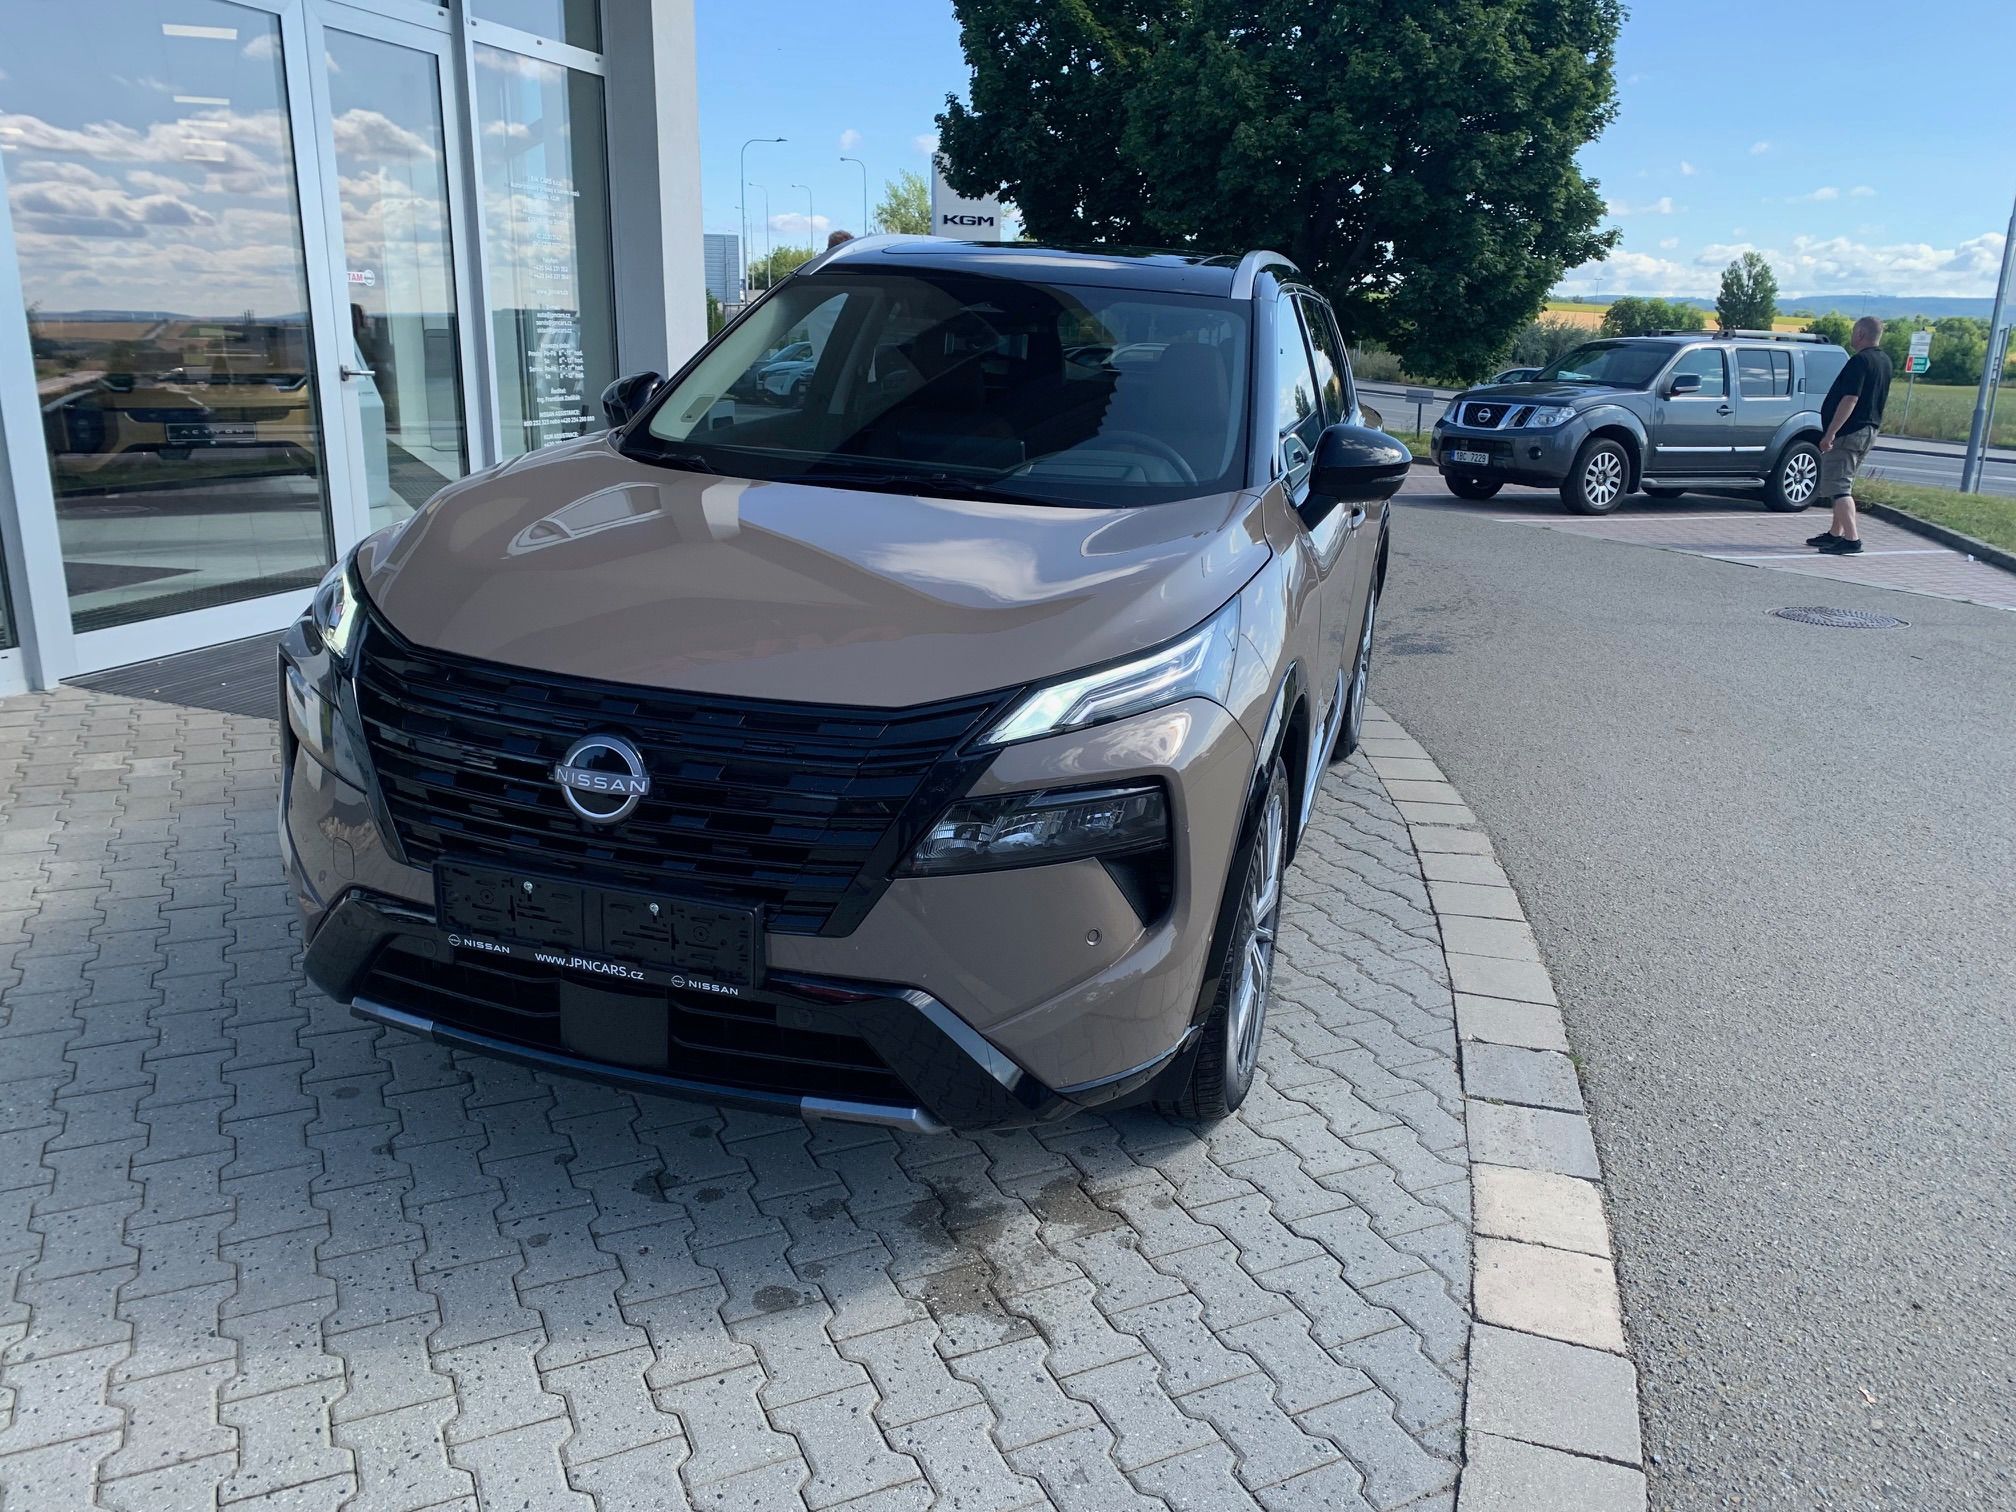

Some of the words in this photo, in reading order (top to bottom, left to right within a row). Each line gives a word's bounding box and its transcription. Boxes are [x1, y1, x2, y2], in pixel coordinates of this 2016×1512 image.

[943, 214, 994, 227] KGM
[347, 272, 364, 281] TAM
[556, 768, 646, 793] NISSAN
[464, 939, 510, 954] NISSAN
[534, 952, 645, 980] www.JPNCARS.cz
[688, 980, 739, 996] NISSAN
